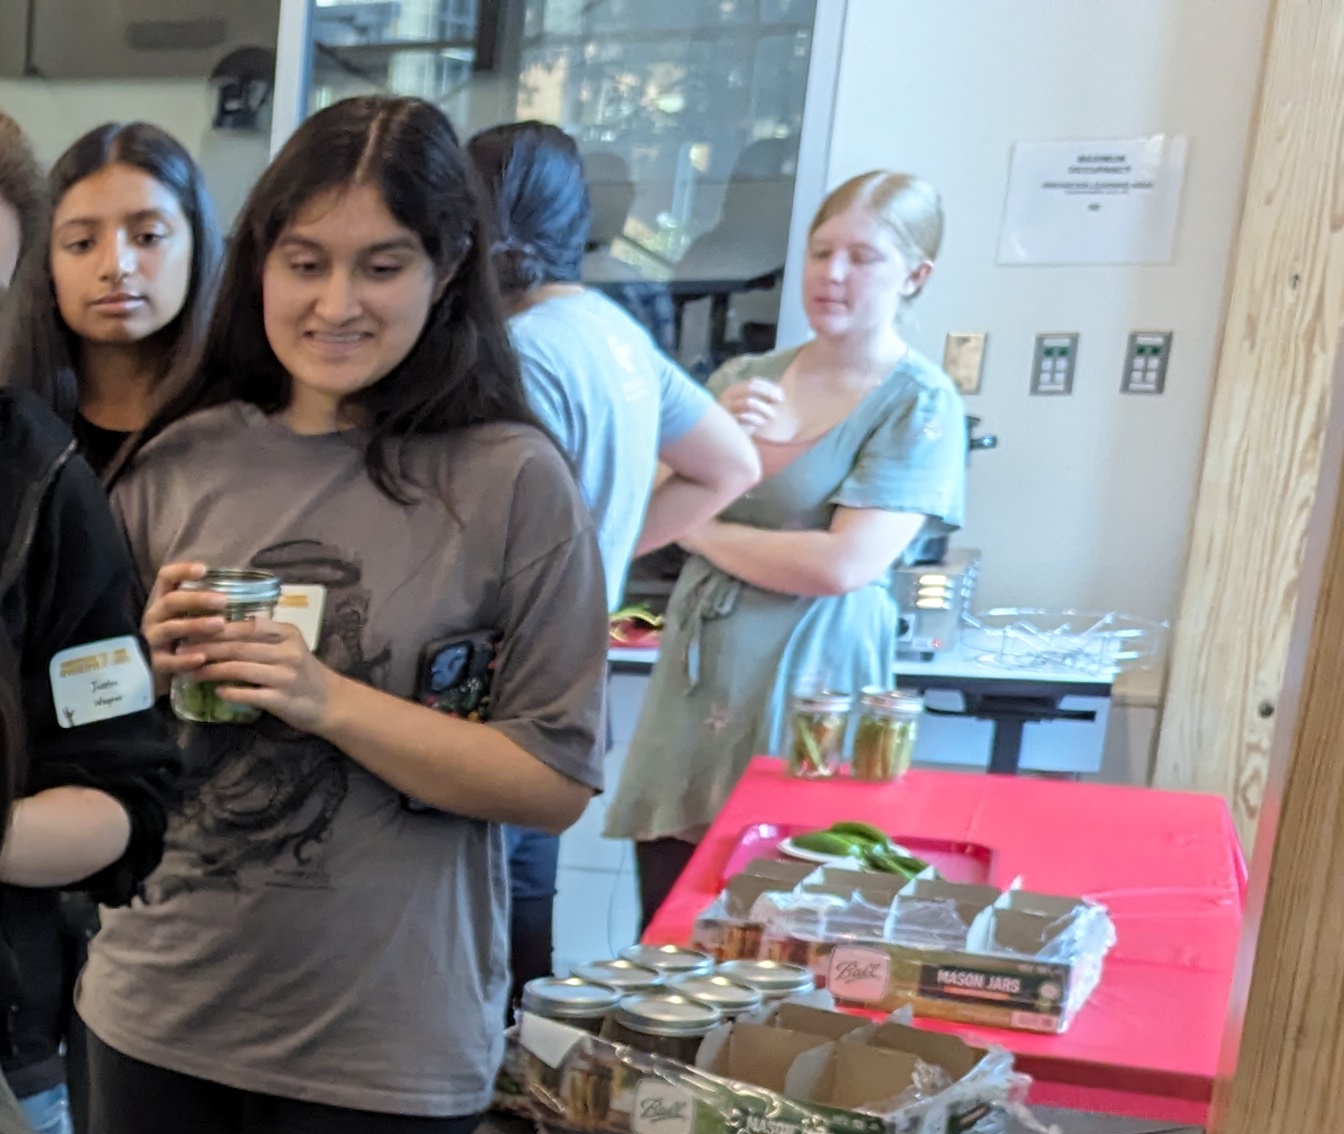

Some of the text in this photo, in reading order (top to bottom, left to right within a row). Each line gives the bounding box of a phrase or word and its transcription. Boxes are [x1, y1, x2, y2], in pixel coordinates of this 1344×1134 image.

[835, 960, 882, 984] Ball
[937, 970, 1021, 993] MASON JARS
[639, 1099, 687, 1123] Ball
